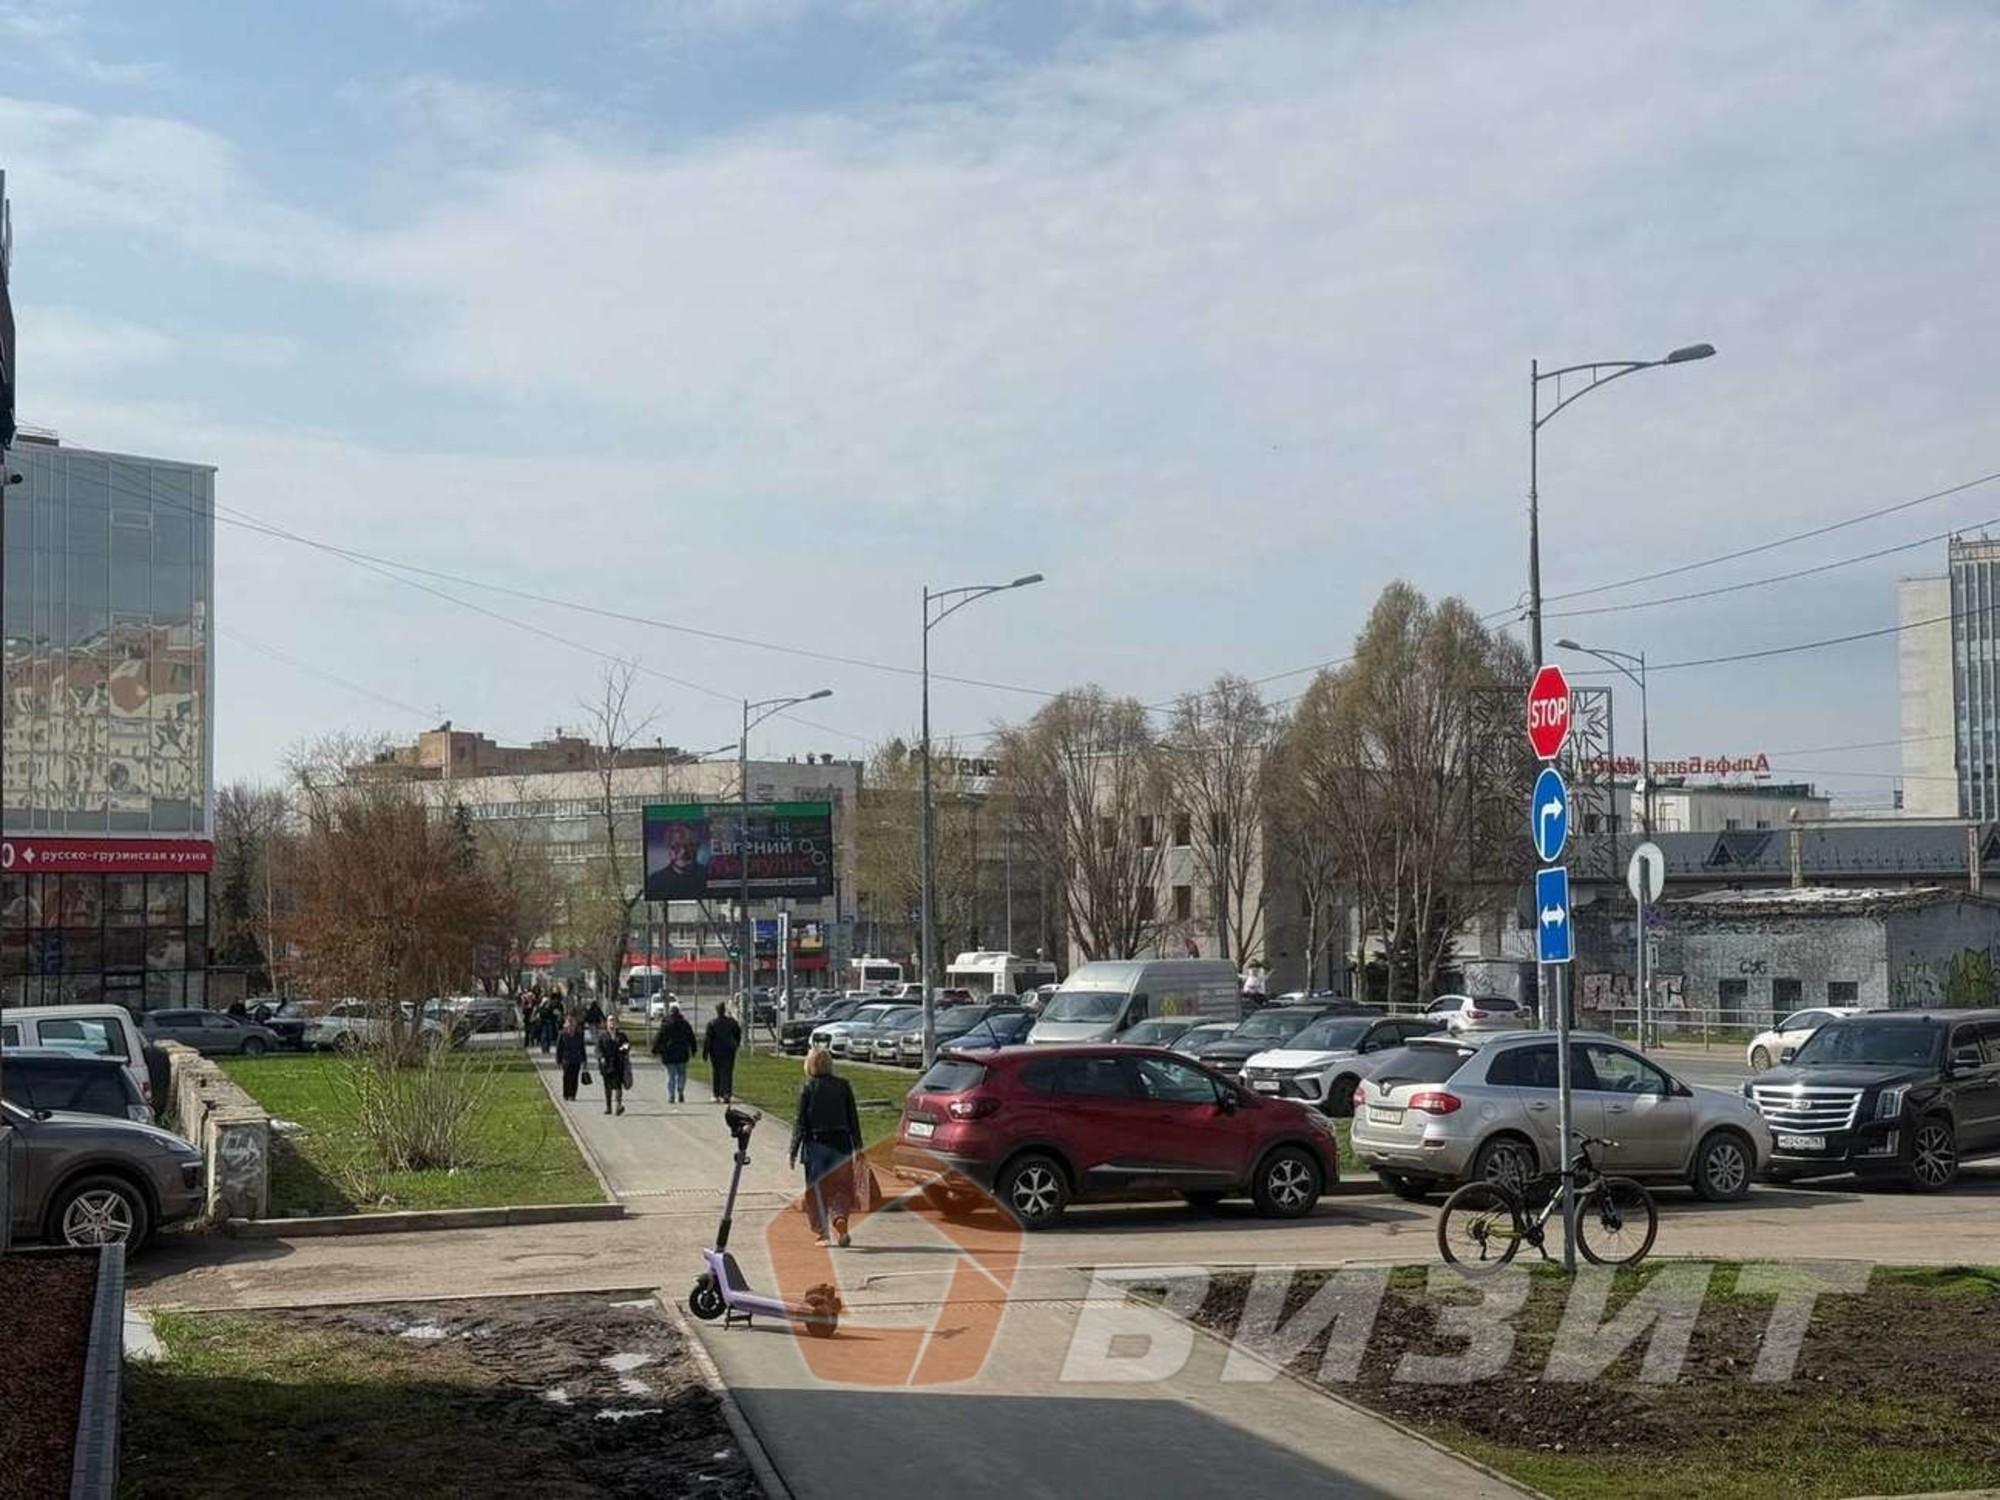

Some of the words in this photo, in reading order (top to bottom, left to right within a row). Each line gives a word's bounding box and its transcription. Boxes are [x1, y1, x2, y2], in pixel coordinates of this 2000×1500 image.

[1531, 697, 1567, 728] STOP
[711, 836, 793, 855] Евгений
[41, 851, 167, 863] русско-грузинская
